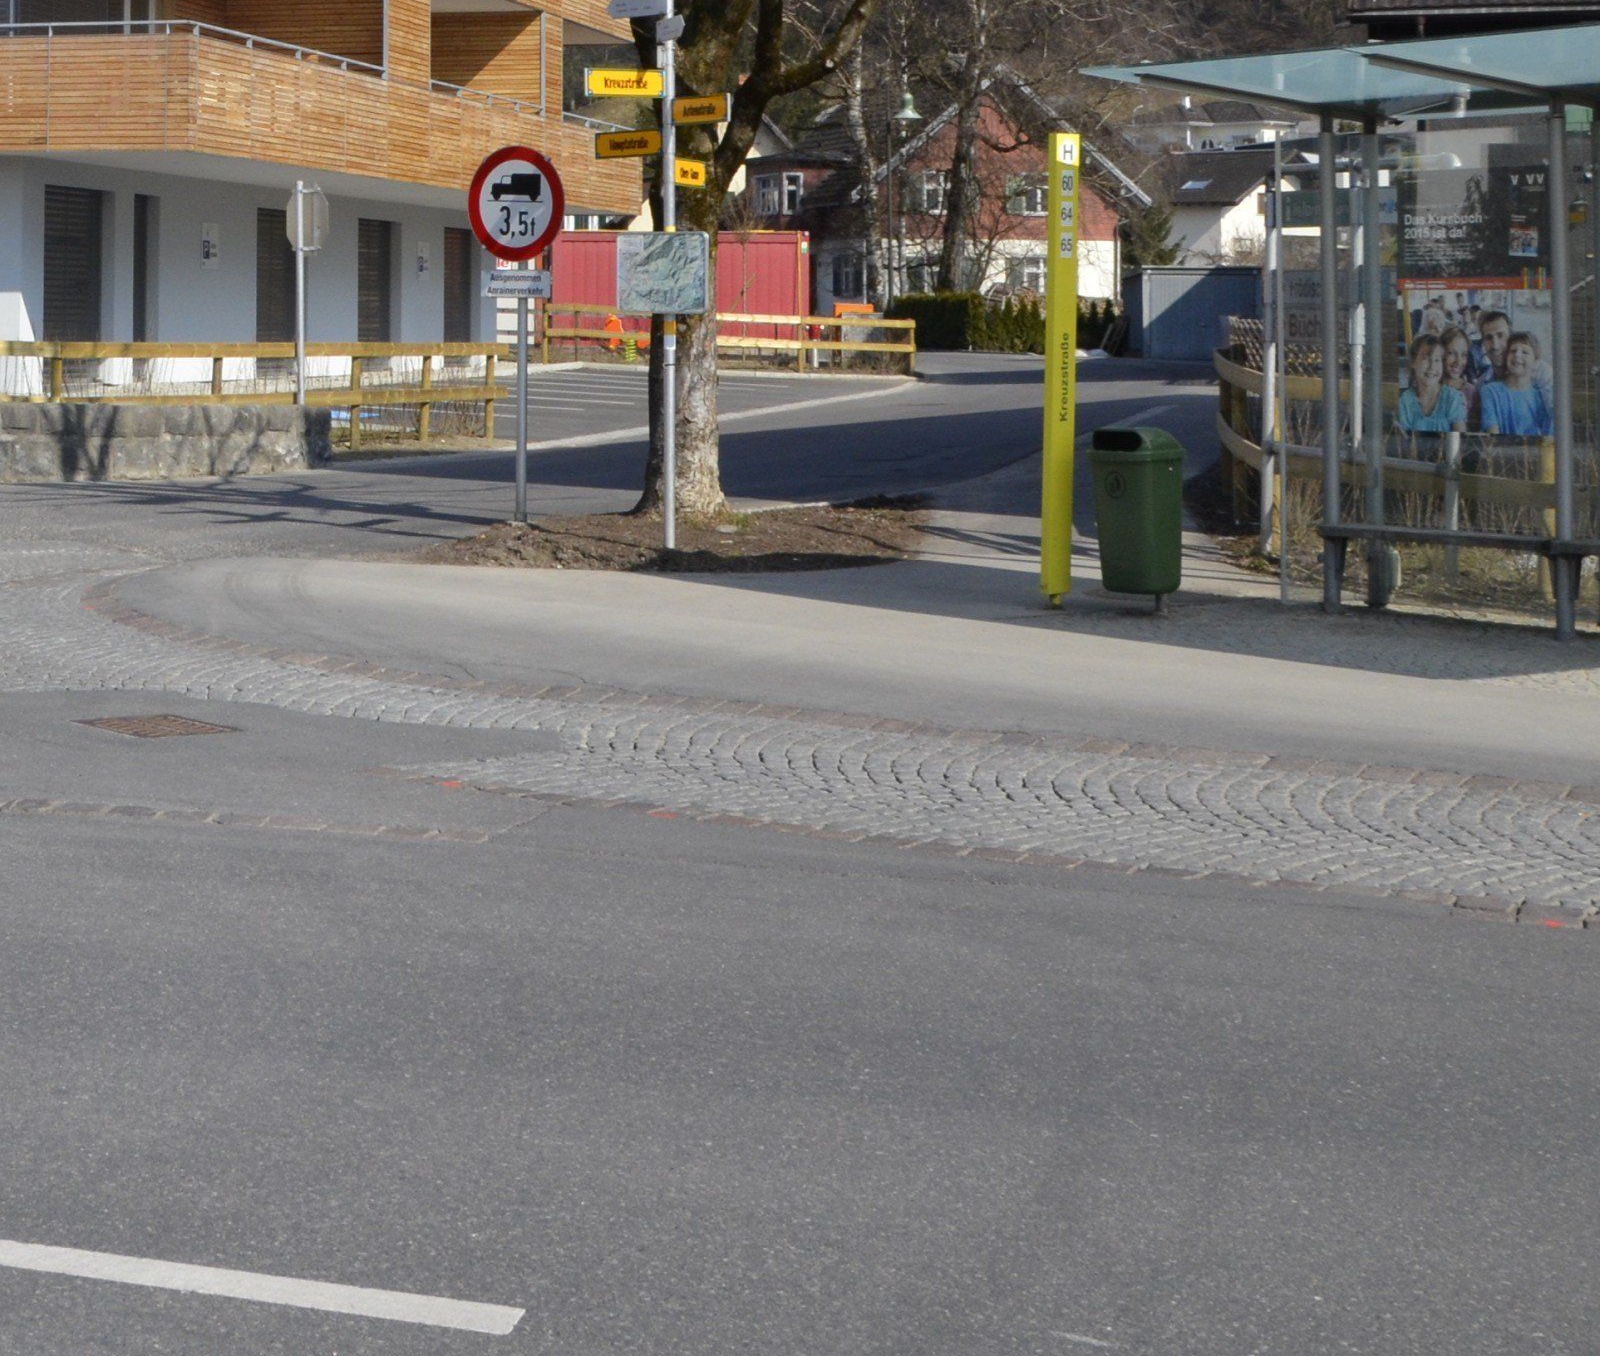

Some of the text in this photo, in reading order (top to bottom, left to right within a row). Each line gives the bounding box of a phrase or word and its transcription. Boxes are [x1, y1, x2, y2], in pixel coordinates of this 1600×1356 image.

[604, 77, 648, 90] Kreuzstraße
[609, 135, 649, 152] Hauptstraße
[1063, 145, 1074, 161] H
[1062, 175, 1074, 191] 60
[1061, 207, 1073, 221] 64
[1404, 212, 1483, 225] Das Kursbuch
[1404, 225, 1466, 239] 2015 ist da!
[1061, 237, 1073, 252] 65
[490, 273, 542, 284] Ausgenommen
[486, 286, 544, 295] Anrainerverkehr
[1059, 332, 1069, 422] Kreuzstraße
